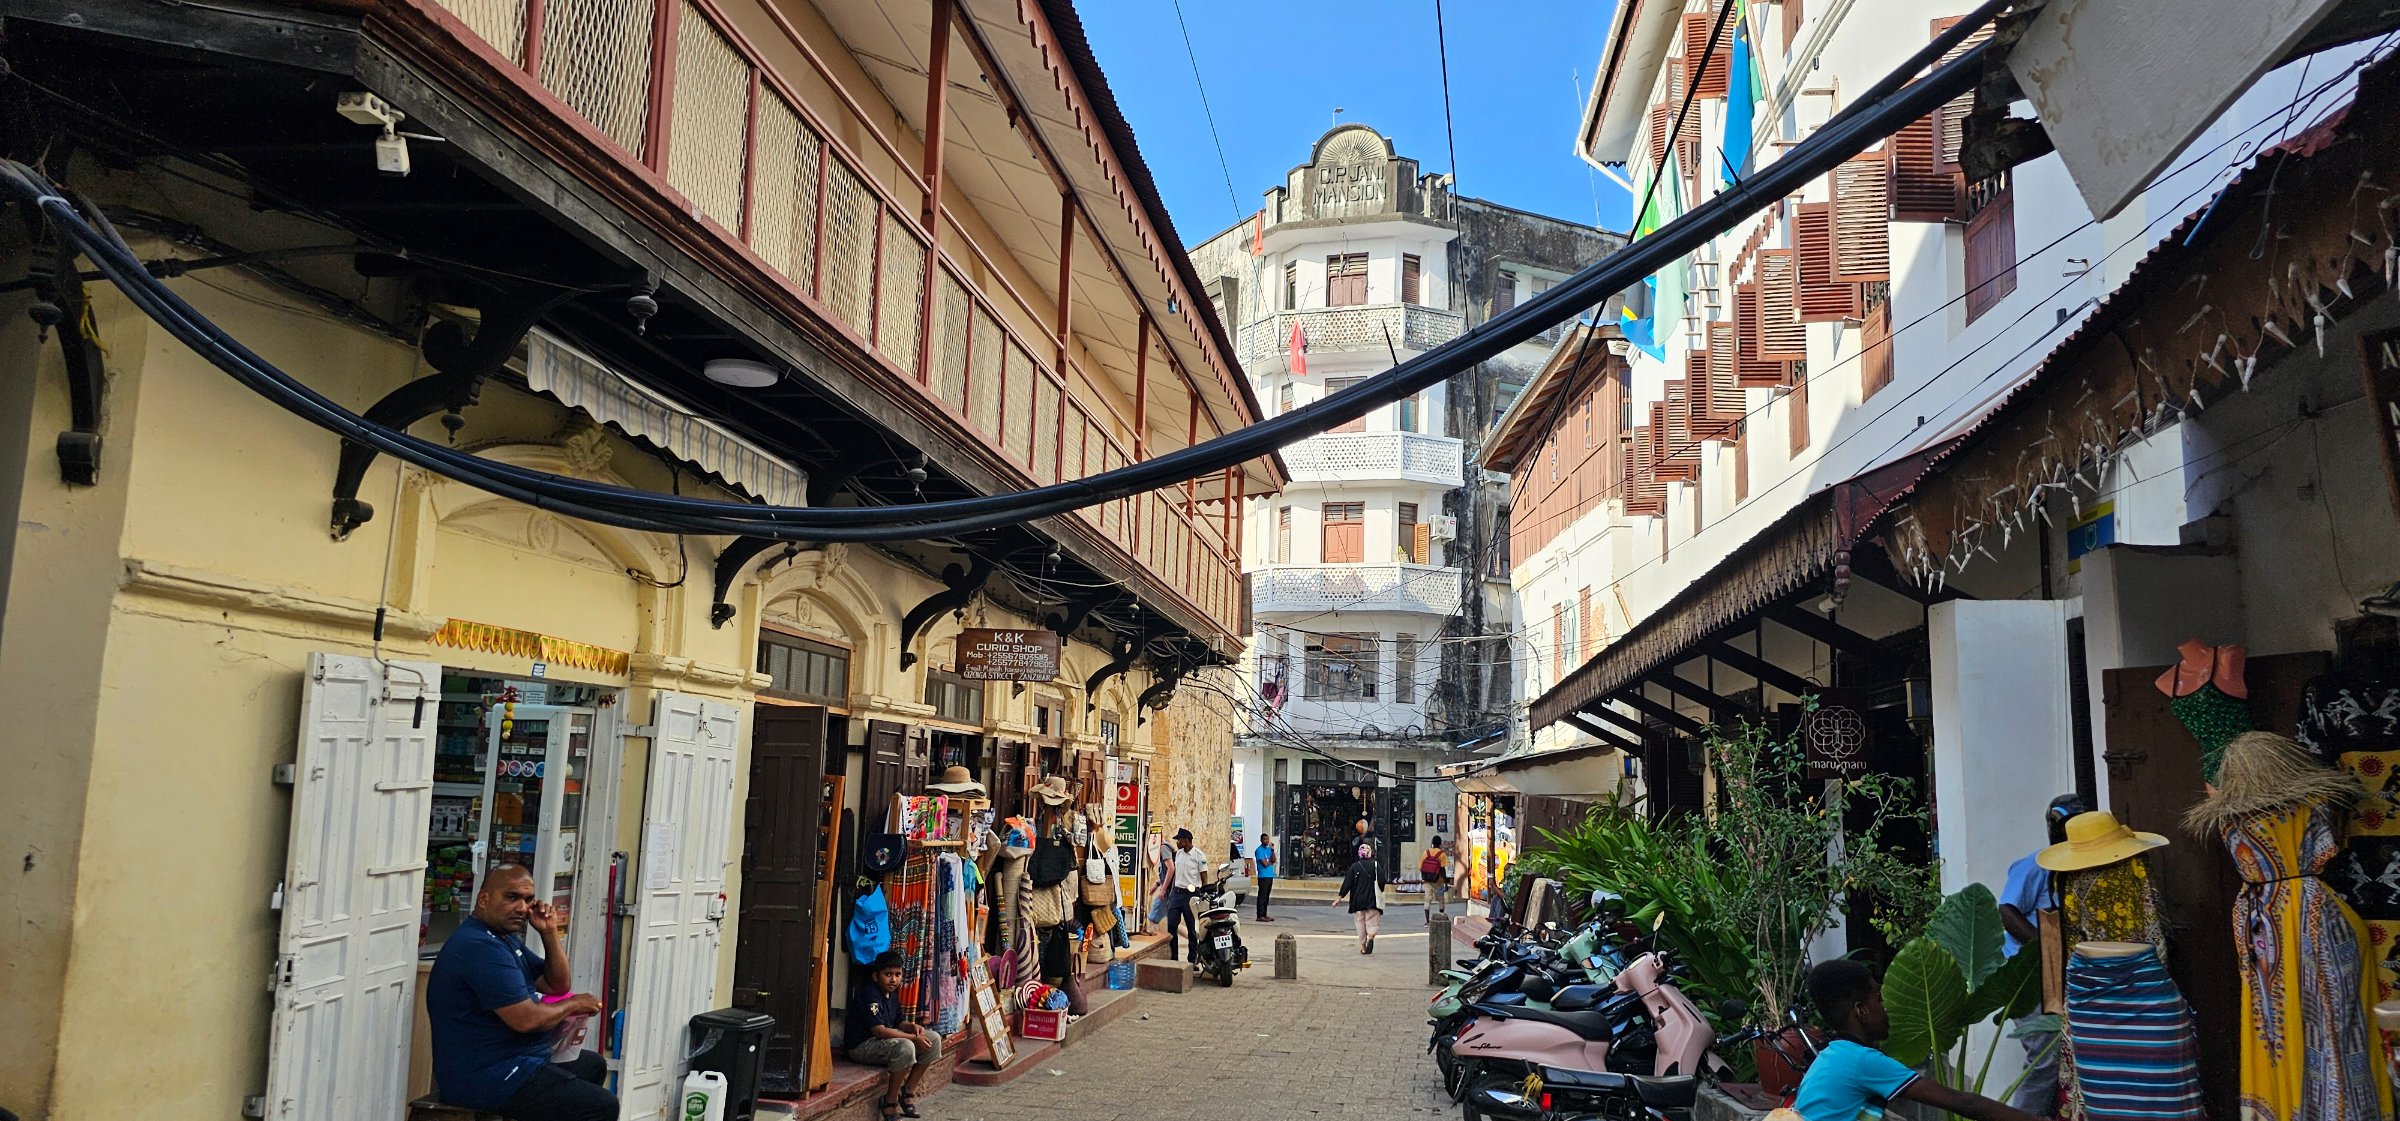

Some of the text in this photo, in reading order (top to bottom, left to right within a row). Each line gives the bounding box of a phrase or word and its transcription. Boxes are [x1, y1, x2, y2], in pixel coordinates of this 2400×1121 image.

[1349, 165, 1384, 182] JANI
[1313, 182, 1387, 204] MANSION
[976, 643, 1042, 653] CURIO SHOP
[988, 672, 1014, 680] STREET
[1811, 760, 1867, 769] maru maru
[1115, 832, 1136, 842] ANTEL
